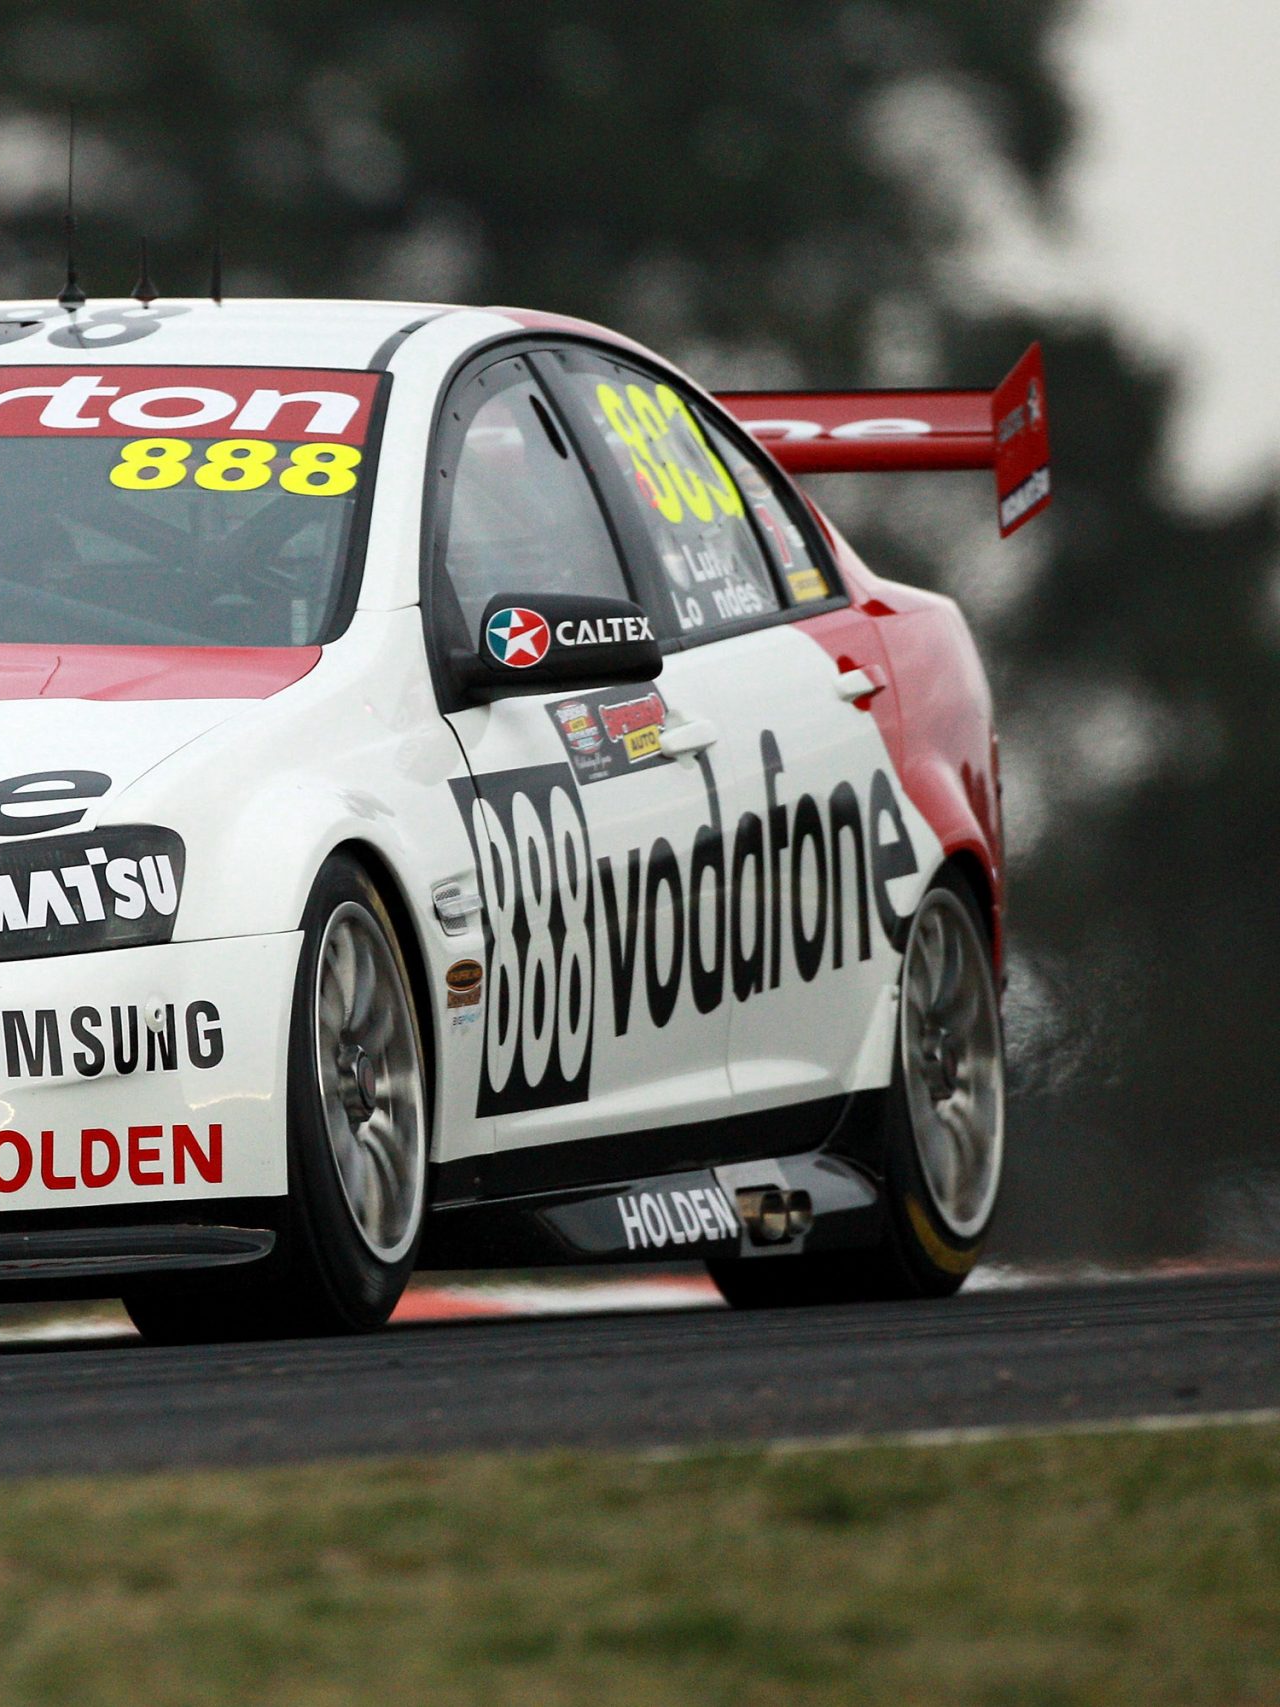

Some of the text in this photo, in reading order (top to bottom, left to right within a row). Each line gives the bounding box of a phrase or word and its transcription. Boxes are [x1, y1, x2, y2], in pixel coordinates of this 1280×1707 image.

[110, 438, 362, 496] 888
[556, 617, 654, 646] CALTEX
[672, 577, 763, 630] Londes
[630, 731, 657, 752] AUTO
[597, 729, 919, 1037] vodafone
[472, 785, 592, 1093] 888
[617, 1187, 738, 1250] HOLDEN
